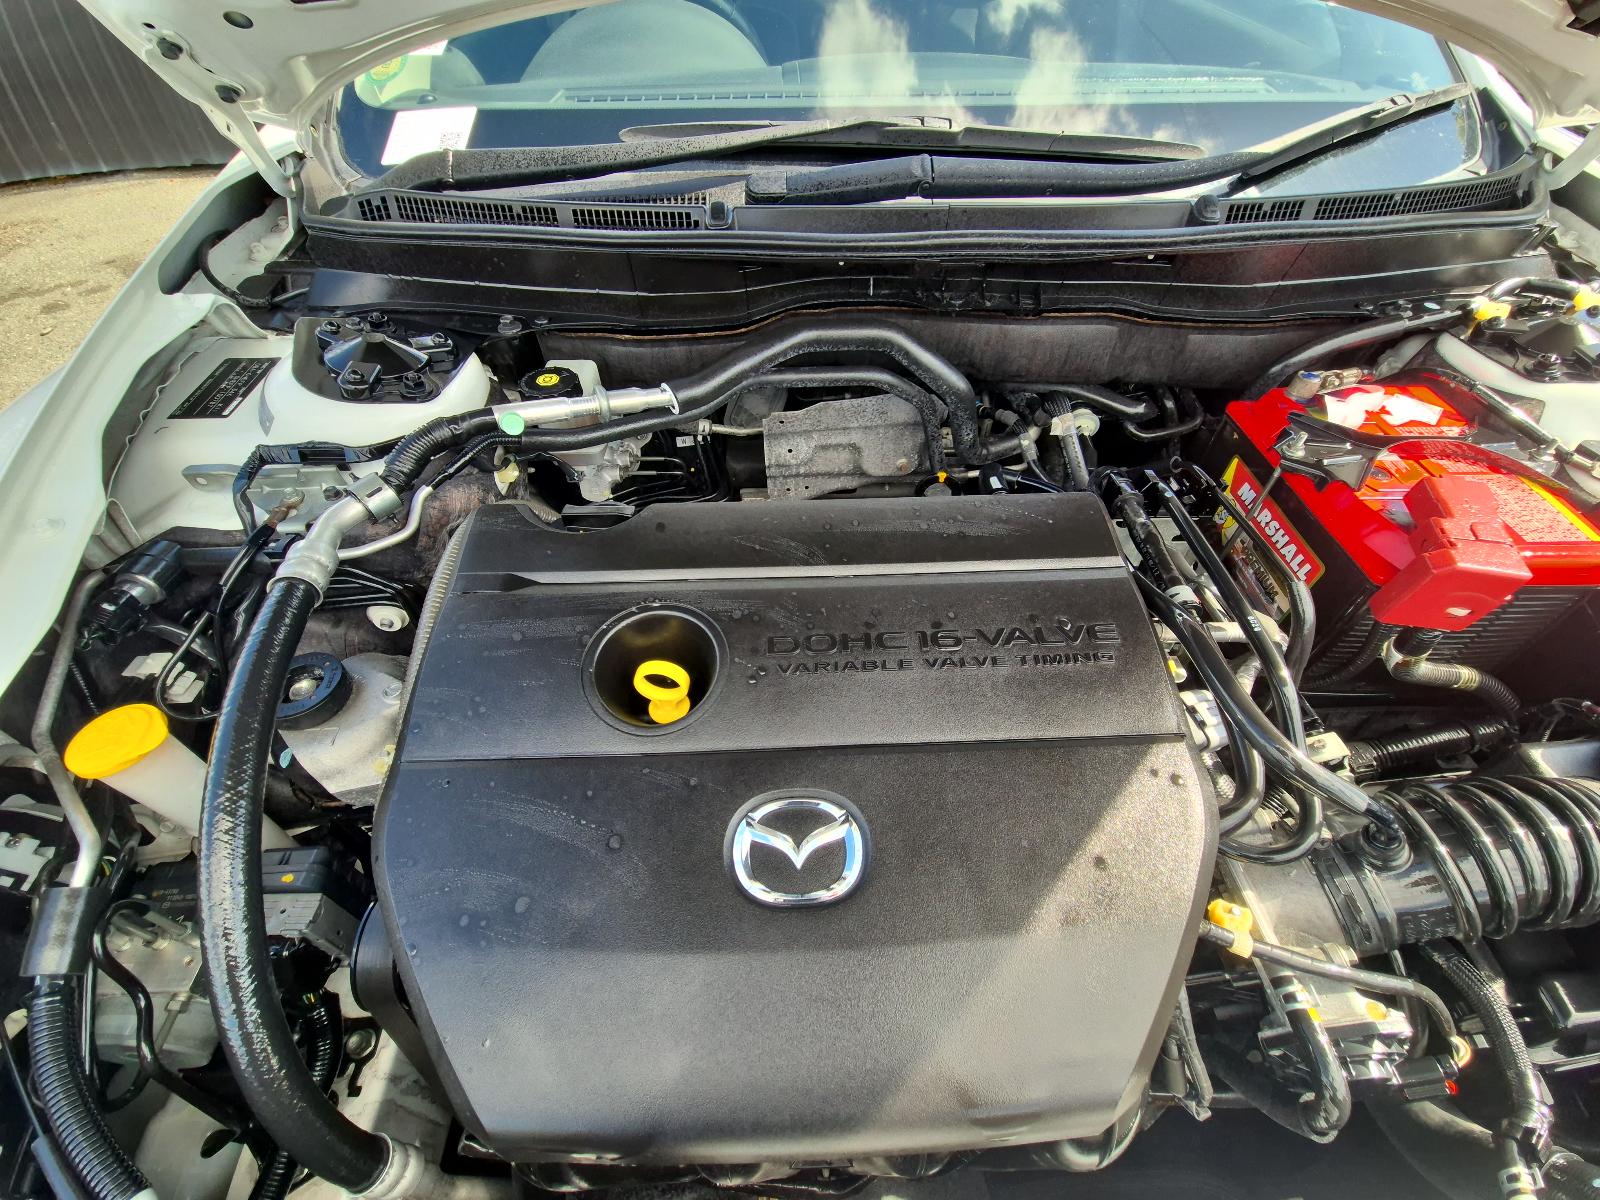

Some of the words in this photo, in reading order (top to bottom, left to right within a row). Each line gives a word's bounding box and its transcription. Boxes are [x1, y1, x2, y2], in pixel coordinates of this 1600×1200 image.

[767, 631, 909, 656] DOHC
[916, 624, 1121, 652] 16-VALVE
[777, 658, 915, 675] VARIABLE
[922, 655, 1009, 671] VALVE
[1015, 651, 1116, 667] TIMING
